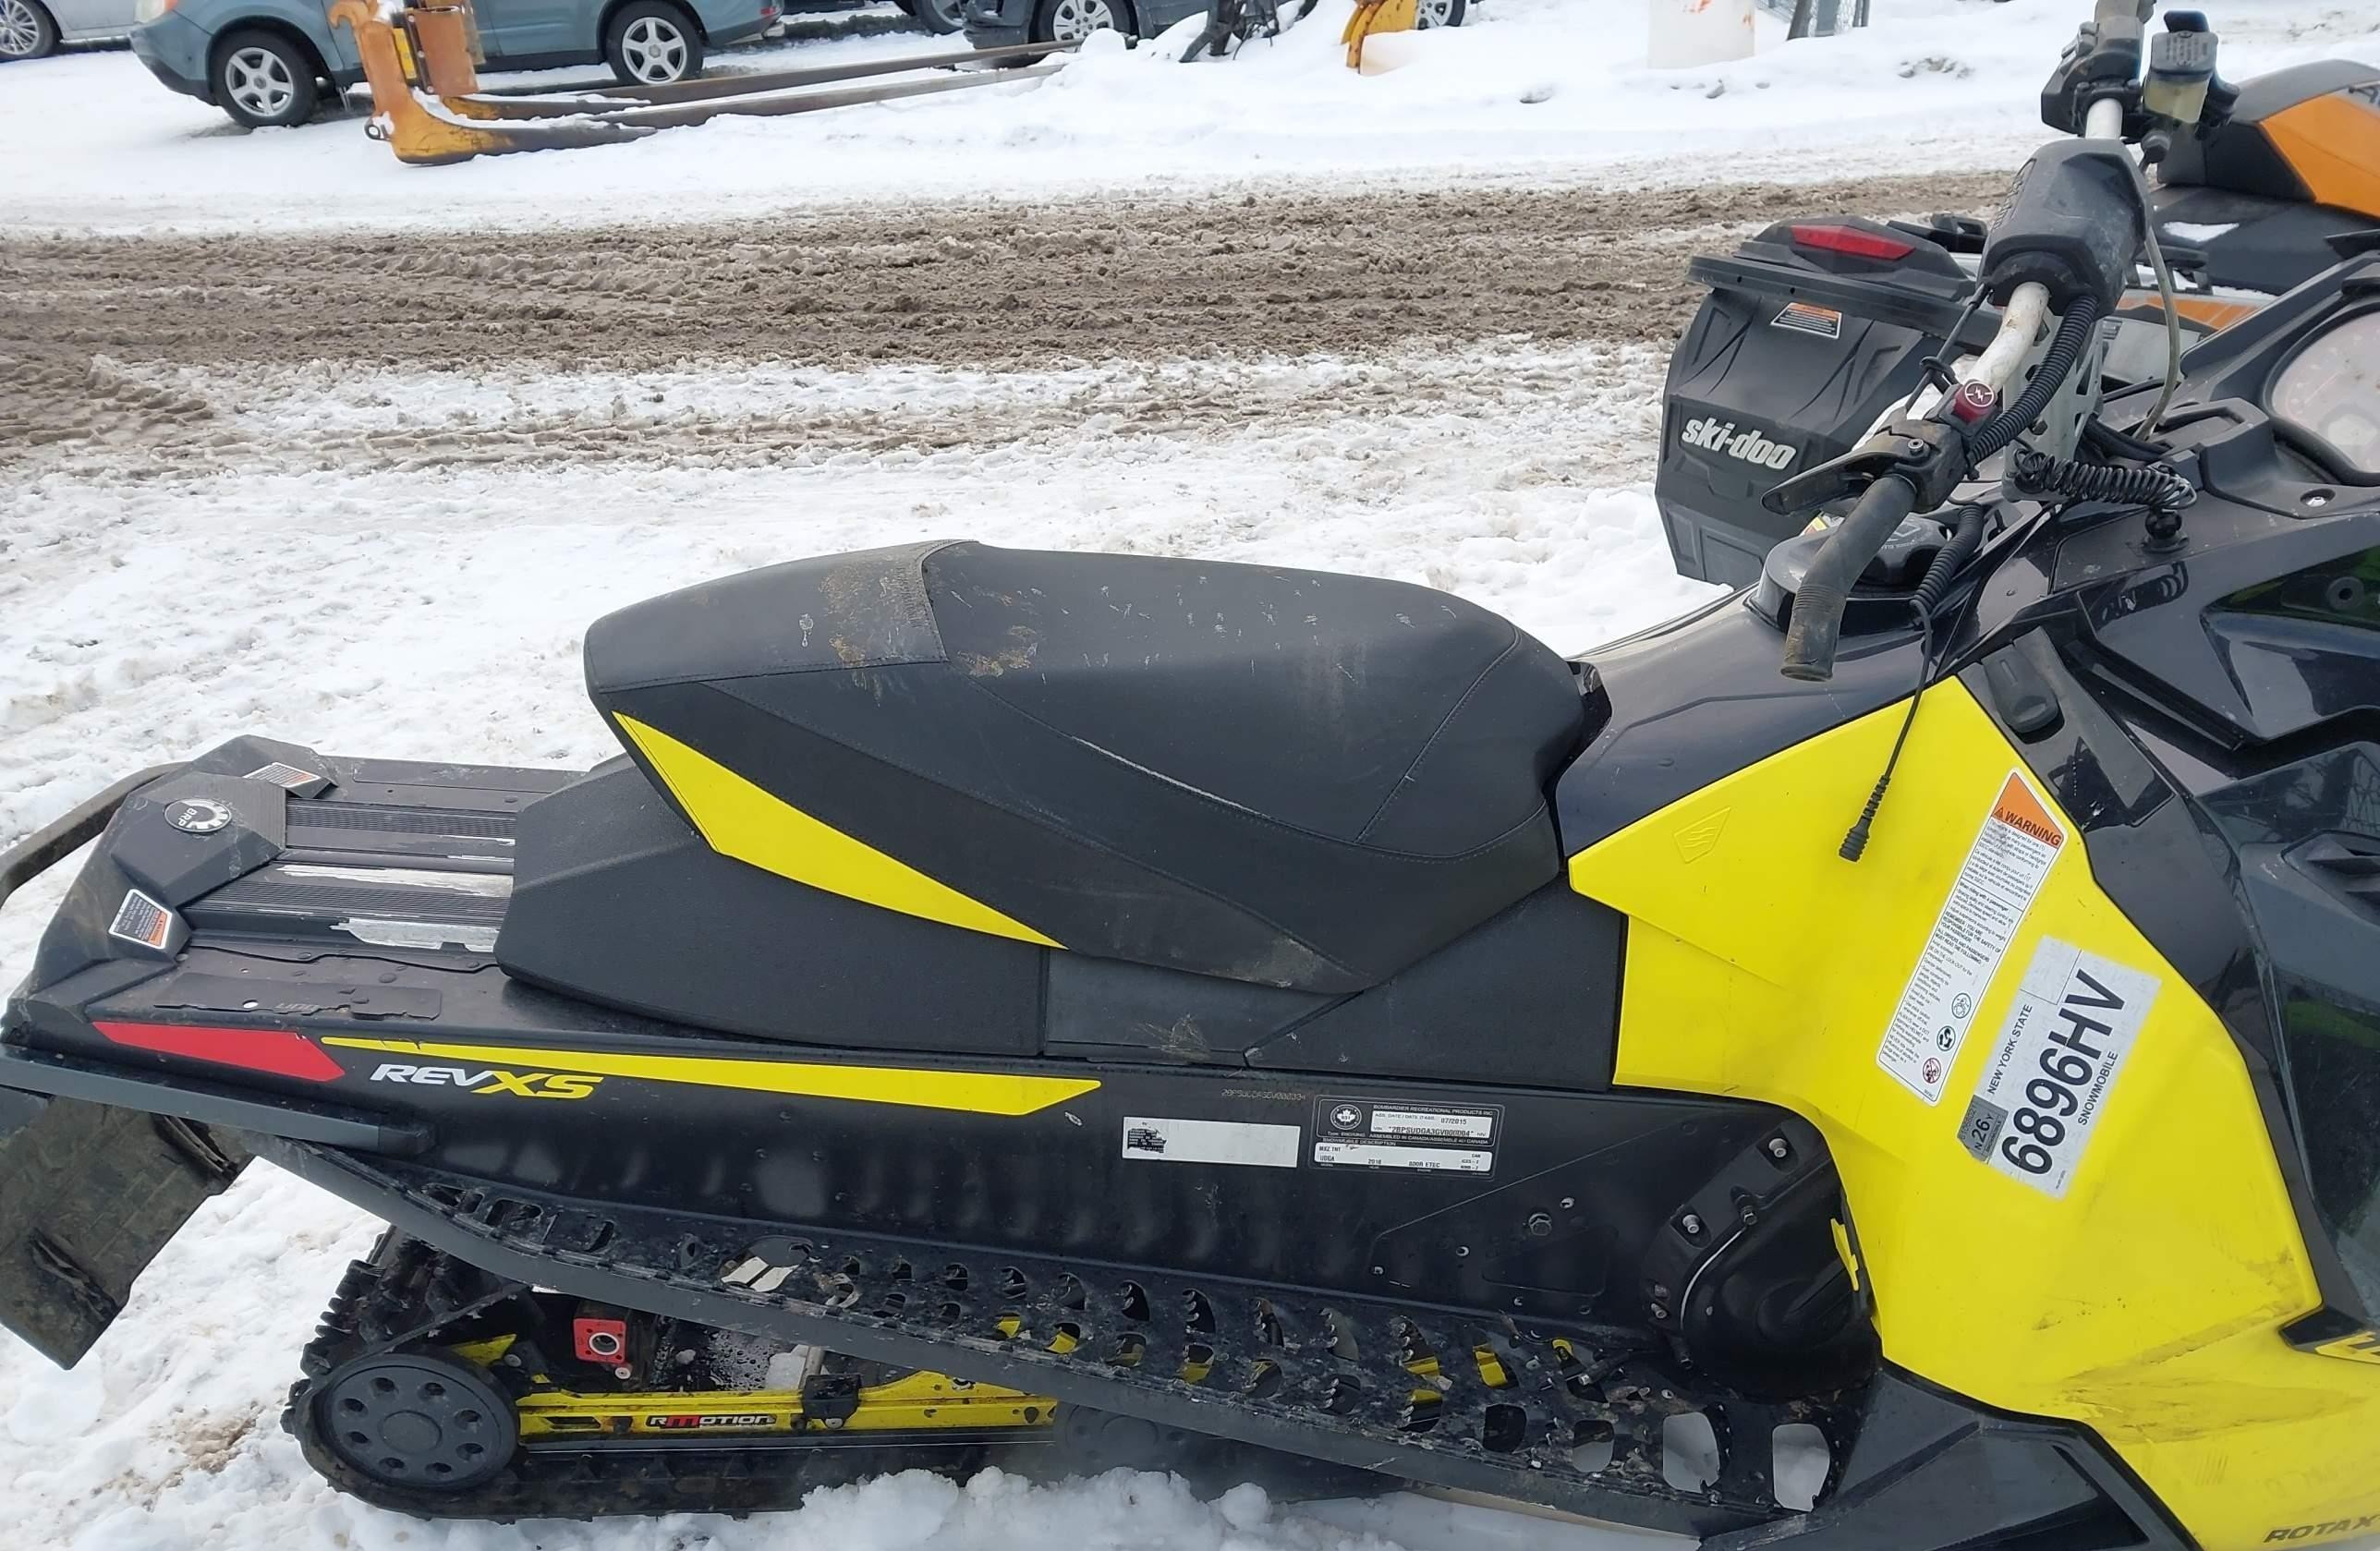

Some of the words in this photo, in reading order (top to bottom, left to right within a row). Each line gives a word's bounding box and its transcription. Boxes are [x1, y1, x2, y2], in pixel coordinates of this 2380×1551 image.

[1682, 417, 1797, 470] ski-doo
[178, 807, 198, 826] BRP
[2004, 810, 2062, 846] WARNING
[1987, 1069, 2004, 1095] NEW
[1998, 1038, 2018, 1068] YORK
[2011, 1003, 2033, 1037] STATE
[2001, 967, 2126, 1175] 6896HV
[2077, 1050, 2119, 1126] SNOWMOBILE
[1440, 1117, 1467, 1125] 07/2015
[1972, 1118, 1990, 1144] 26
[2263, 1515, 2375, 1544] ROTAX
